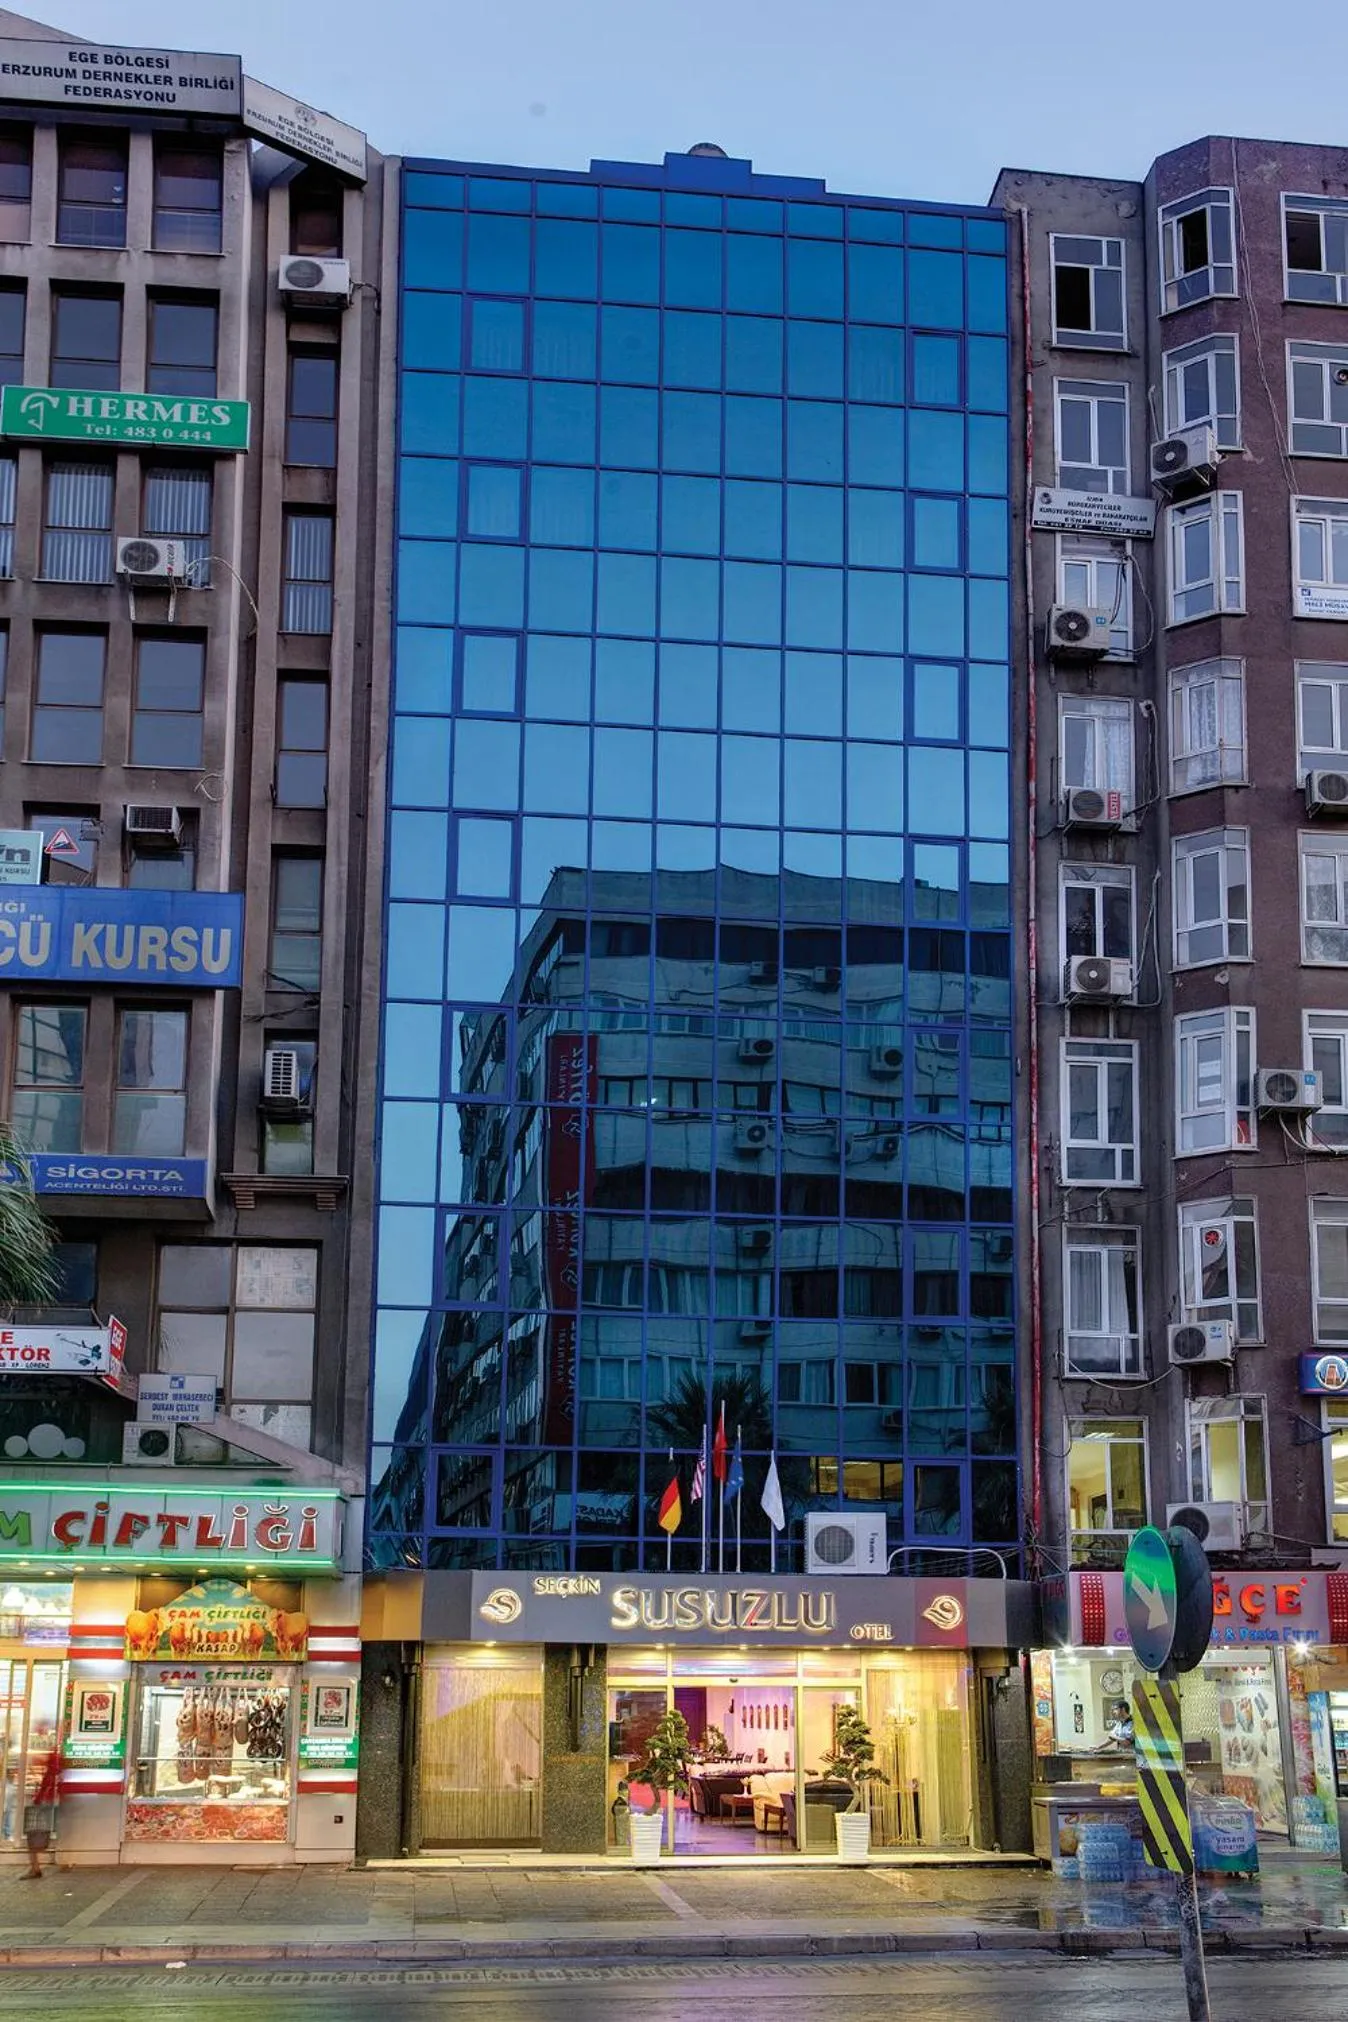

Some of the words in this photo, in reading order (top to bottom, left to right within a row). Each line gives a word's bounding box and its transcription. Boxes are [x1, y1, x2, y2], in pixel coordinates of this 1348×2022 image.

[68, 51, 99, 64] EGE
[103, 51, 170, 69] BÖLGESİ
[1, 63, 77, 80] ERZURUM
[82, 69, 174, 87] DERNEKLER
[178, 74, 235, 91] BİRLİĞİ
[64, 84, 177, 104] FEDERASYONU
[66, 395, 232, 426] HERMES
[82, 423, 118, 436] Tel:
[123, 426, 158, 439] 483
[162, 427, 174, 440] 0
[178, 429, 213, 442] 444
[71, 922, 232, 974] KURSU
[46, 1163, 185, 1182] SİGORTA
[52, 1501, 319, 1553] ÇİFTLİĞİ
[533, 1575, 601, 1599] SEÇKİN
[611, 1586, 836, 1631] SUSUZLU
[1212, 1576, 1302, 1623] ĞÇE
[168, 1609, 201, 1623] ÇAM
[207, 1605, 268, 1623] ÇİFTLİĞİ
[850, 1622, 895, 1641] OTEL
[1239, 1627, 1279, 1641] Pasta
[196, 1642, 238, 1654] KASAP
[159, 1669, 197, 1683] ÇAM
[204, 1666, 273, 1683] ÇİFTLİĞİ
